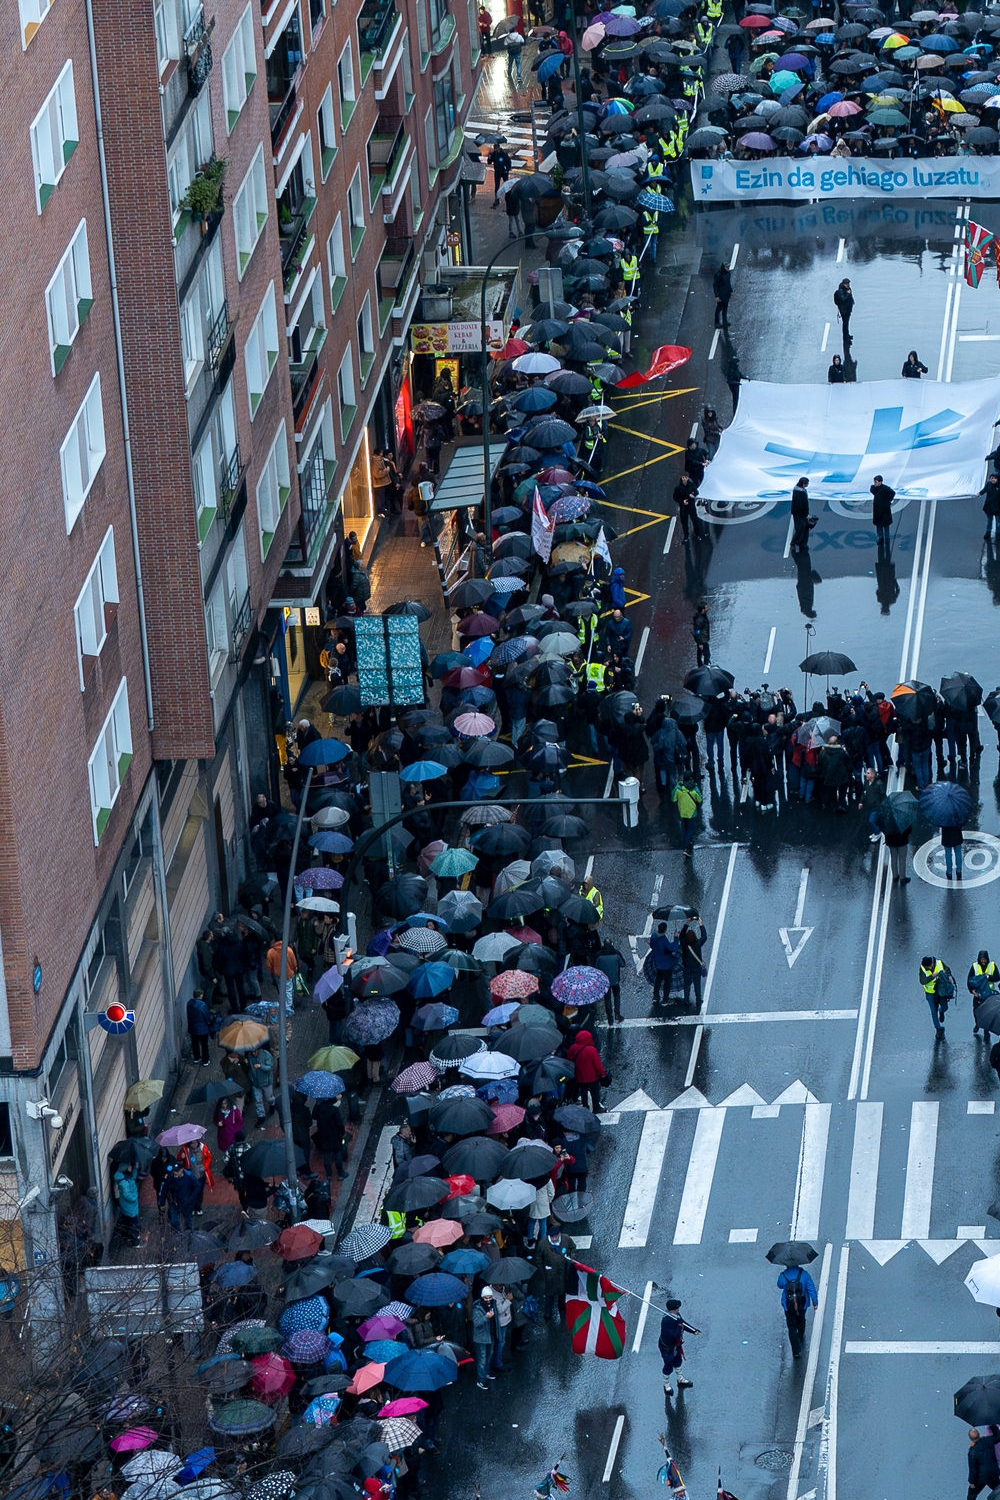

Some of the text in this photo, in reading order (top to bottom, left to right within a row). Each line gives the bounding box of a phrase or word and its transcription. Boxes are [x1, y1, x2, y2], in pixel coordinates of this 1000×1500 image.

[735, 167, 782, 189] Ezin
[787, 166, 815, 188] da
[820, 165, 908, 192] gehiago
